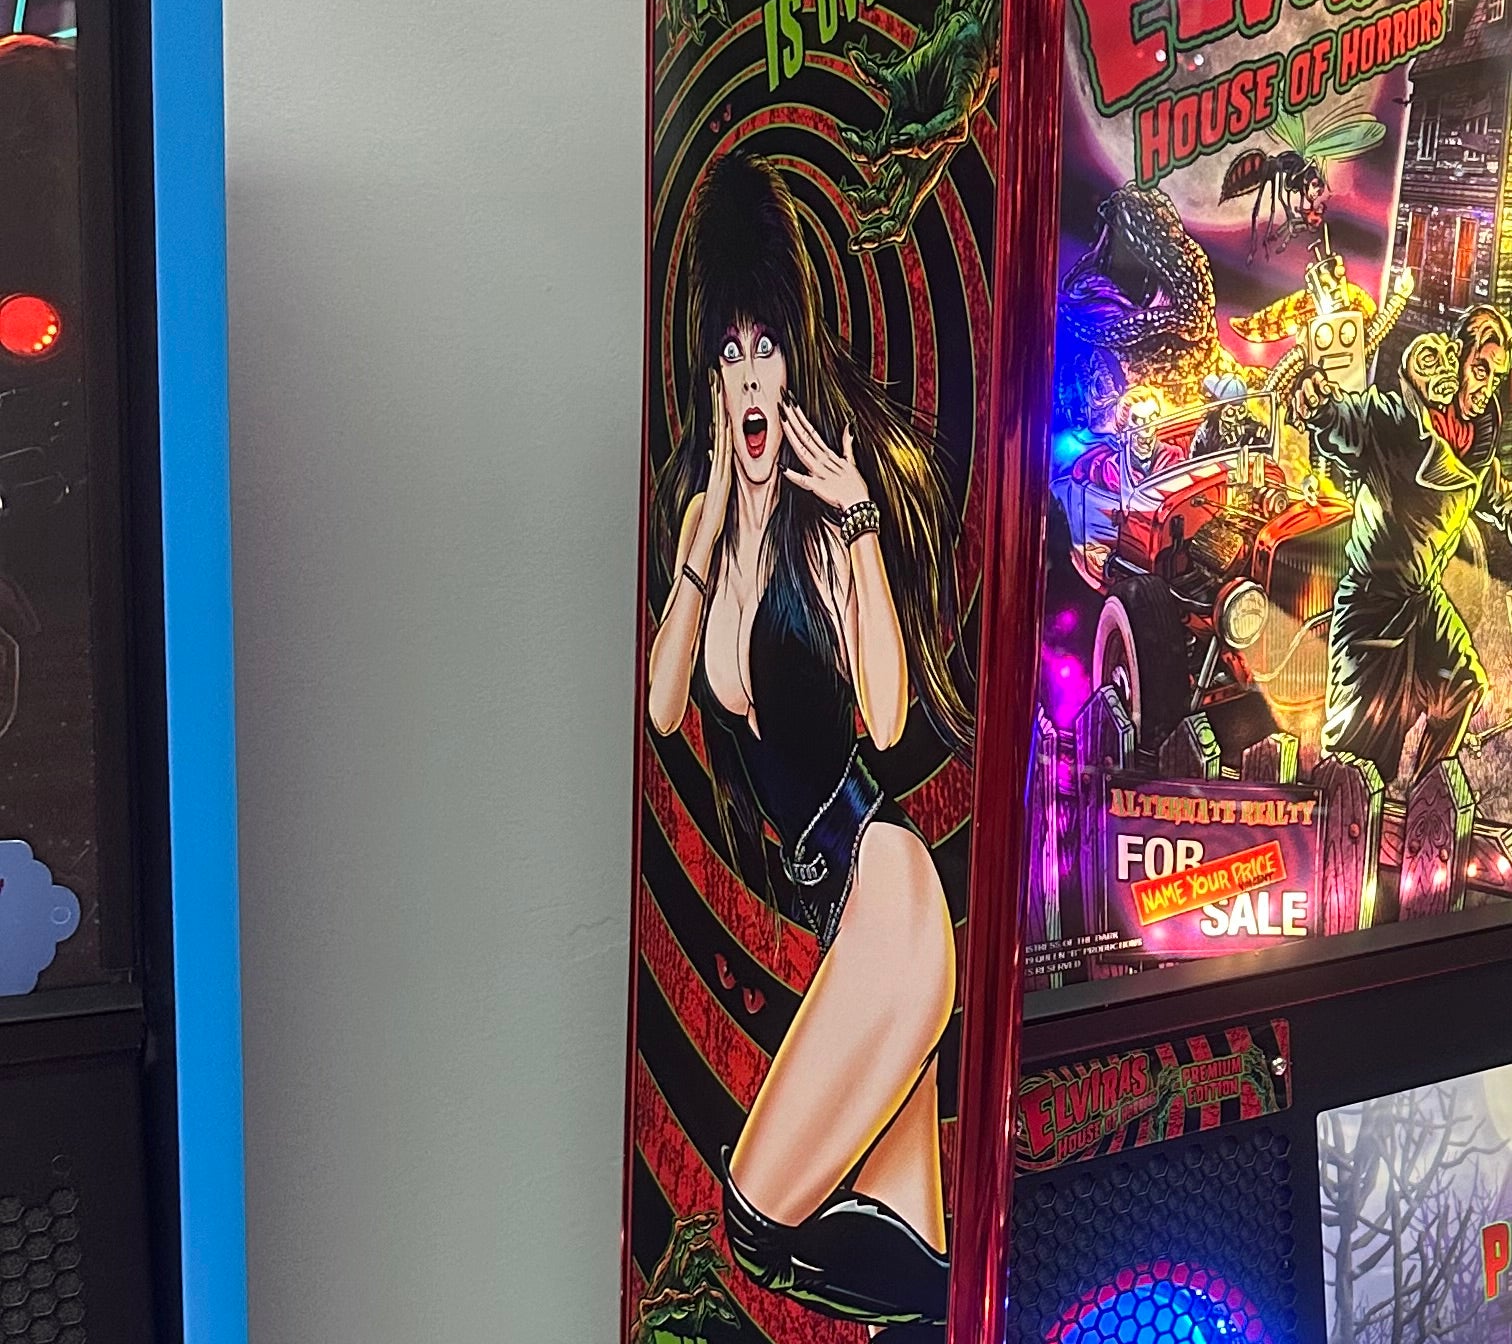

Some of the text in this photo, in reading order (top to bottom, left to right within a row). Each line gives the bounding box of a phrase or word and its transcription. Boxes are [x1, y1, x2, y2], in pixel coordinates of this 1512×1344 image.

[1135, 58, 1282, 187] HOUSE
[1285, 39, 1337, 108] OF
[1108, 788, 1317, 826] ALTERNATE REALTY
[1117, 834, 1205, 881] FOR
[1140, 851, 1278, 915] NAME YOUR PRICE
[1200, 890, 1309, 936] SALE
[1181, 1055, 1243, 1086] PREMIUM
[1186, 1077, 1239, 1106] EDITION
[1057, 1123, 1101, 1161] HOUSE
[1104, 1112, 1118, 1134] OF
